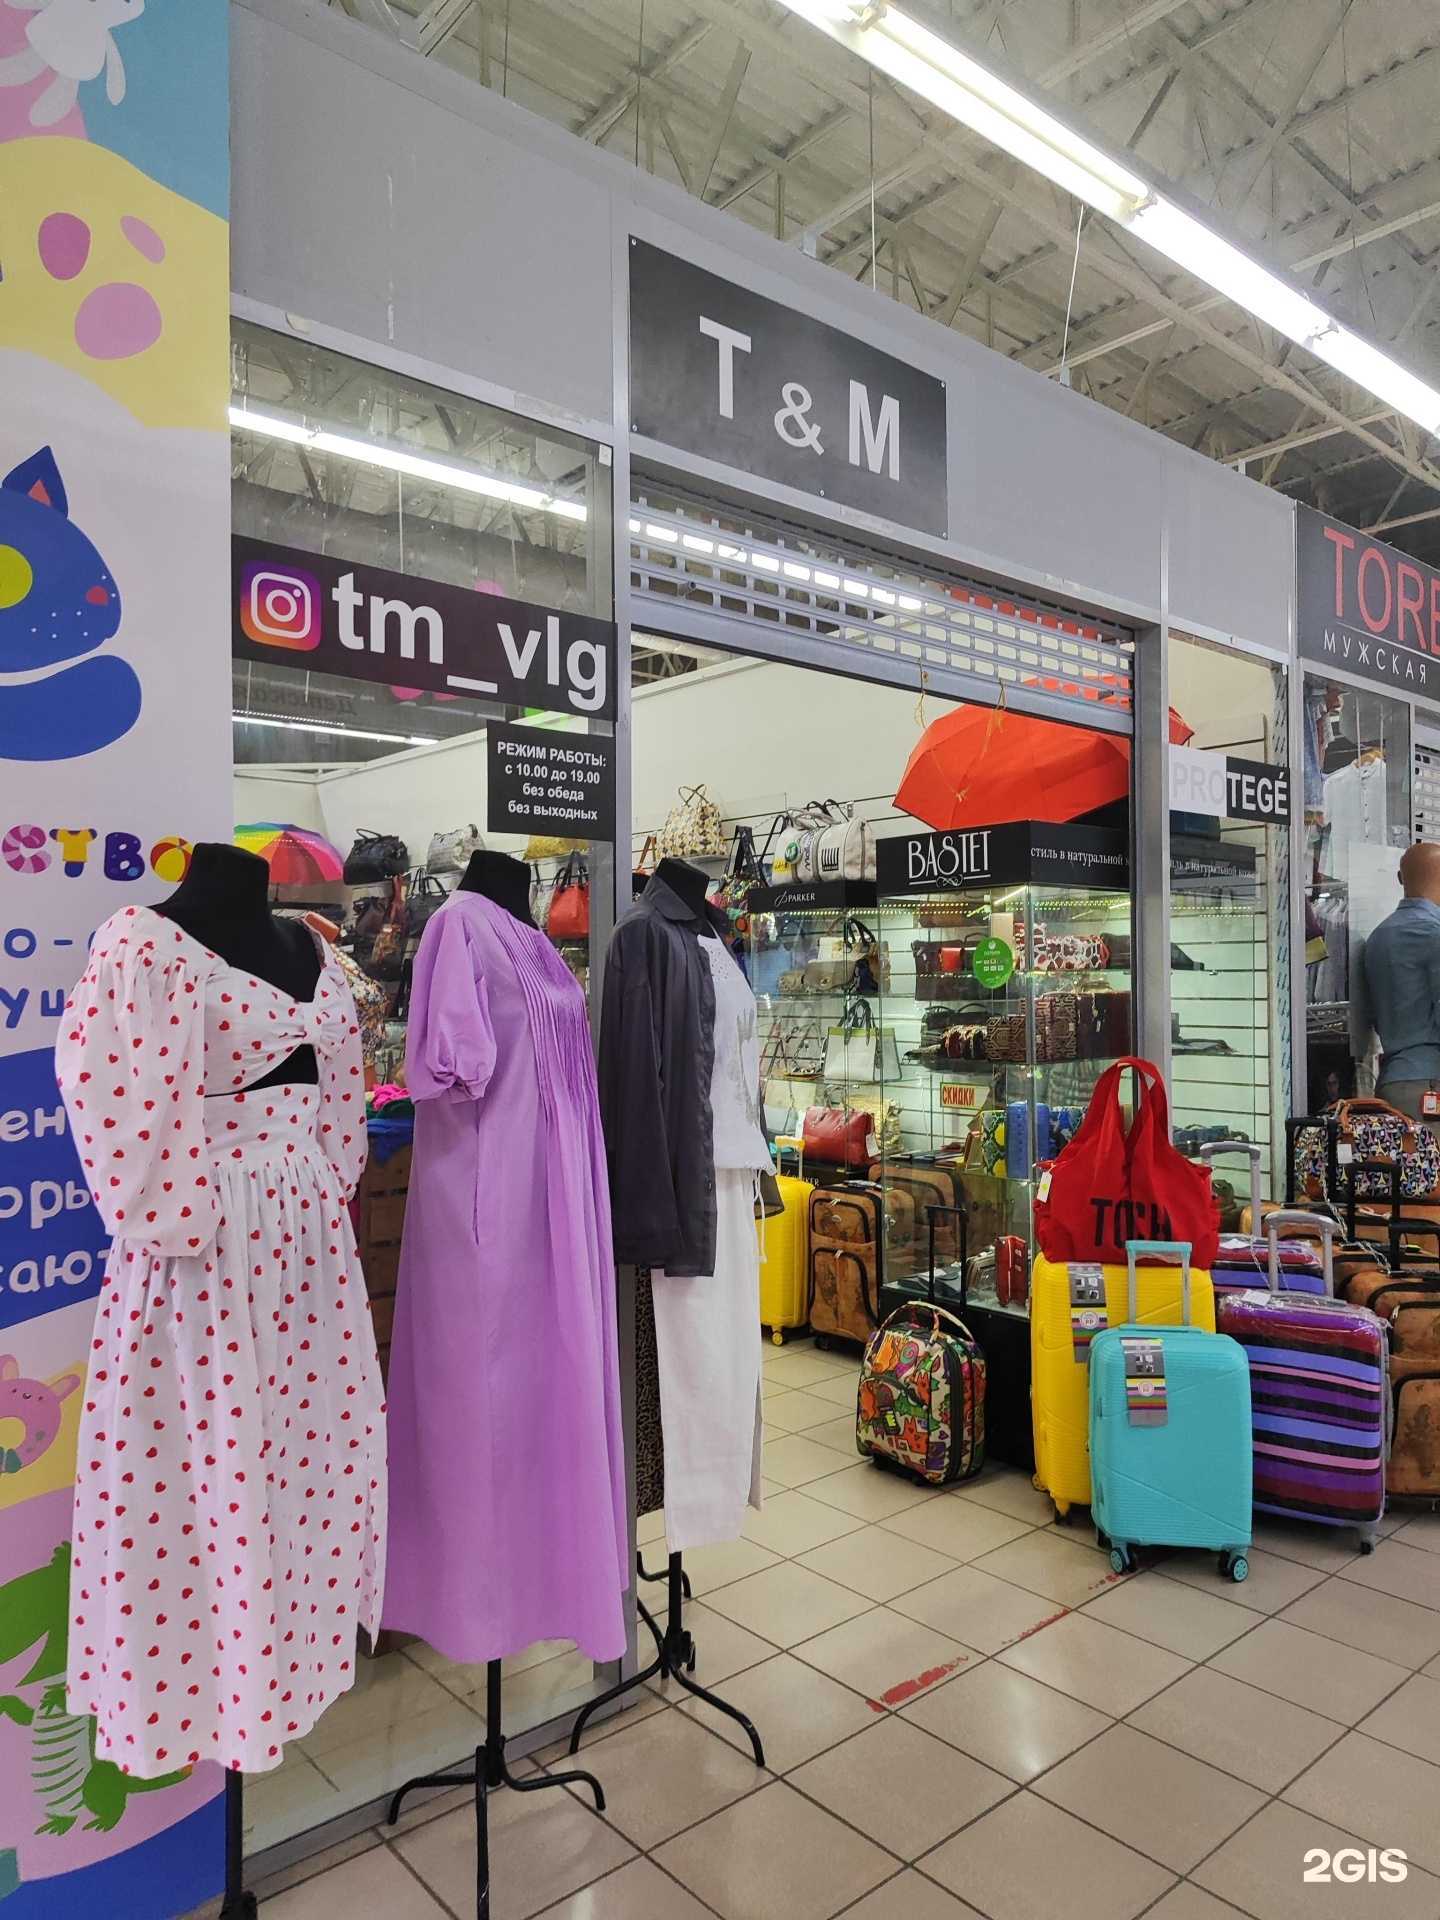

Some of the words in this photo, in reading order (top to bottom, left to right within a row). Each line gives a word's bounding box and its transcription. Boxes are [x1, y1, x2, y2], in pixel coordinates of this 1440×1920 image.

[700, 315, 751, 419] T
[774, 382, 824, 455] &
[849, 379, 900, 482] M
[332, 572, 607, 711] tm_vlg
[1323, 629, 1427, 684] МУЖСКАЯ
[497, 741, 547, 760] РЕЖИМ
[550, 748, 607, 767] РАБОТЫ:
[505, 764, 513, 774] с
[516, 763, 548, 778] 10.00
[550, 770, 567, 781] до
[570, 769, 600, 784] 19.00
[522, 782, 545, 797] без
[547, 786, 584, 802] обеда
[508, 800, 530, 814] без
[533, 805, 598, 820] выходных
[908, 829, 992, 879] BASTET
[1030, 847, 1058, 859] стиль
[1060, 850, 1065, 860] в
[1067, 850, 1123, 868] натуральной
[788, 892, 816, 903] PARKER
[943, 1086, 975, 1107] СКИДКИ
